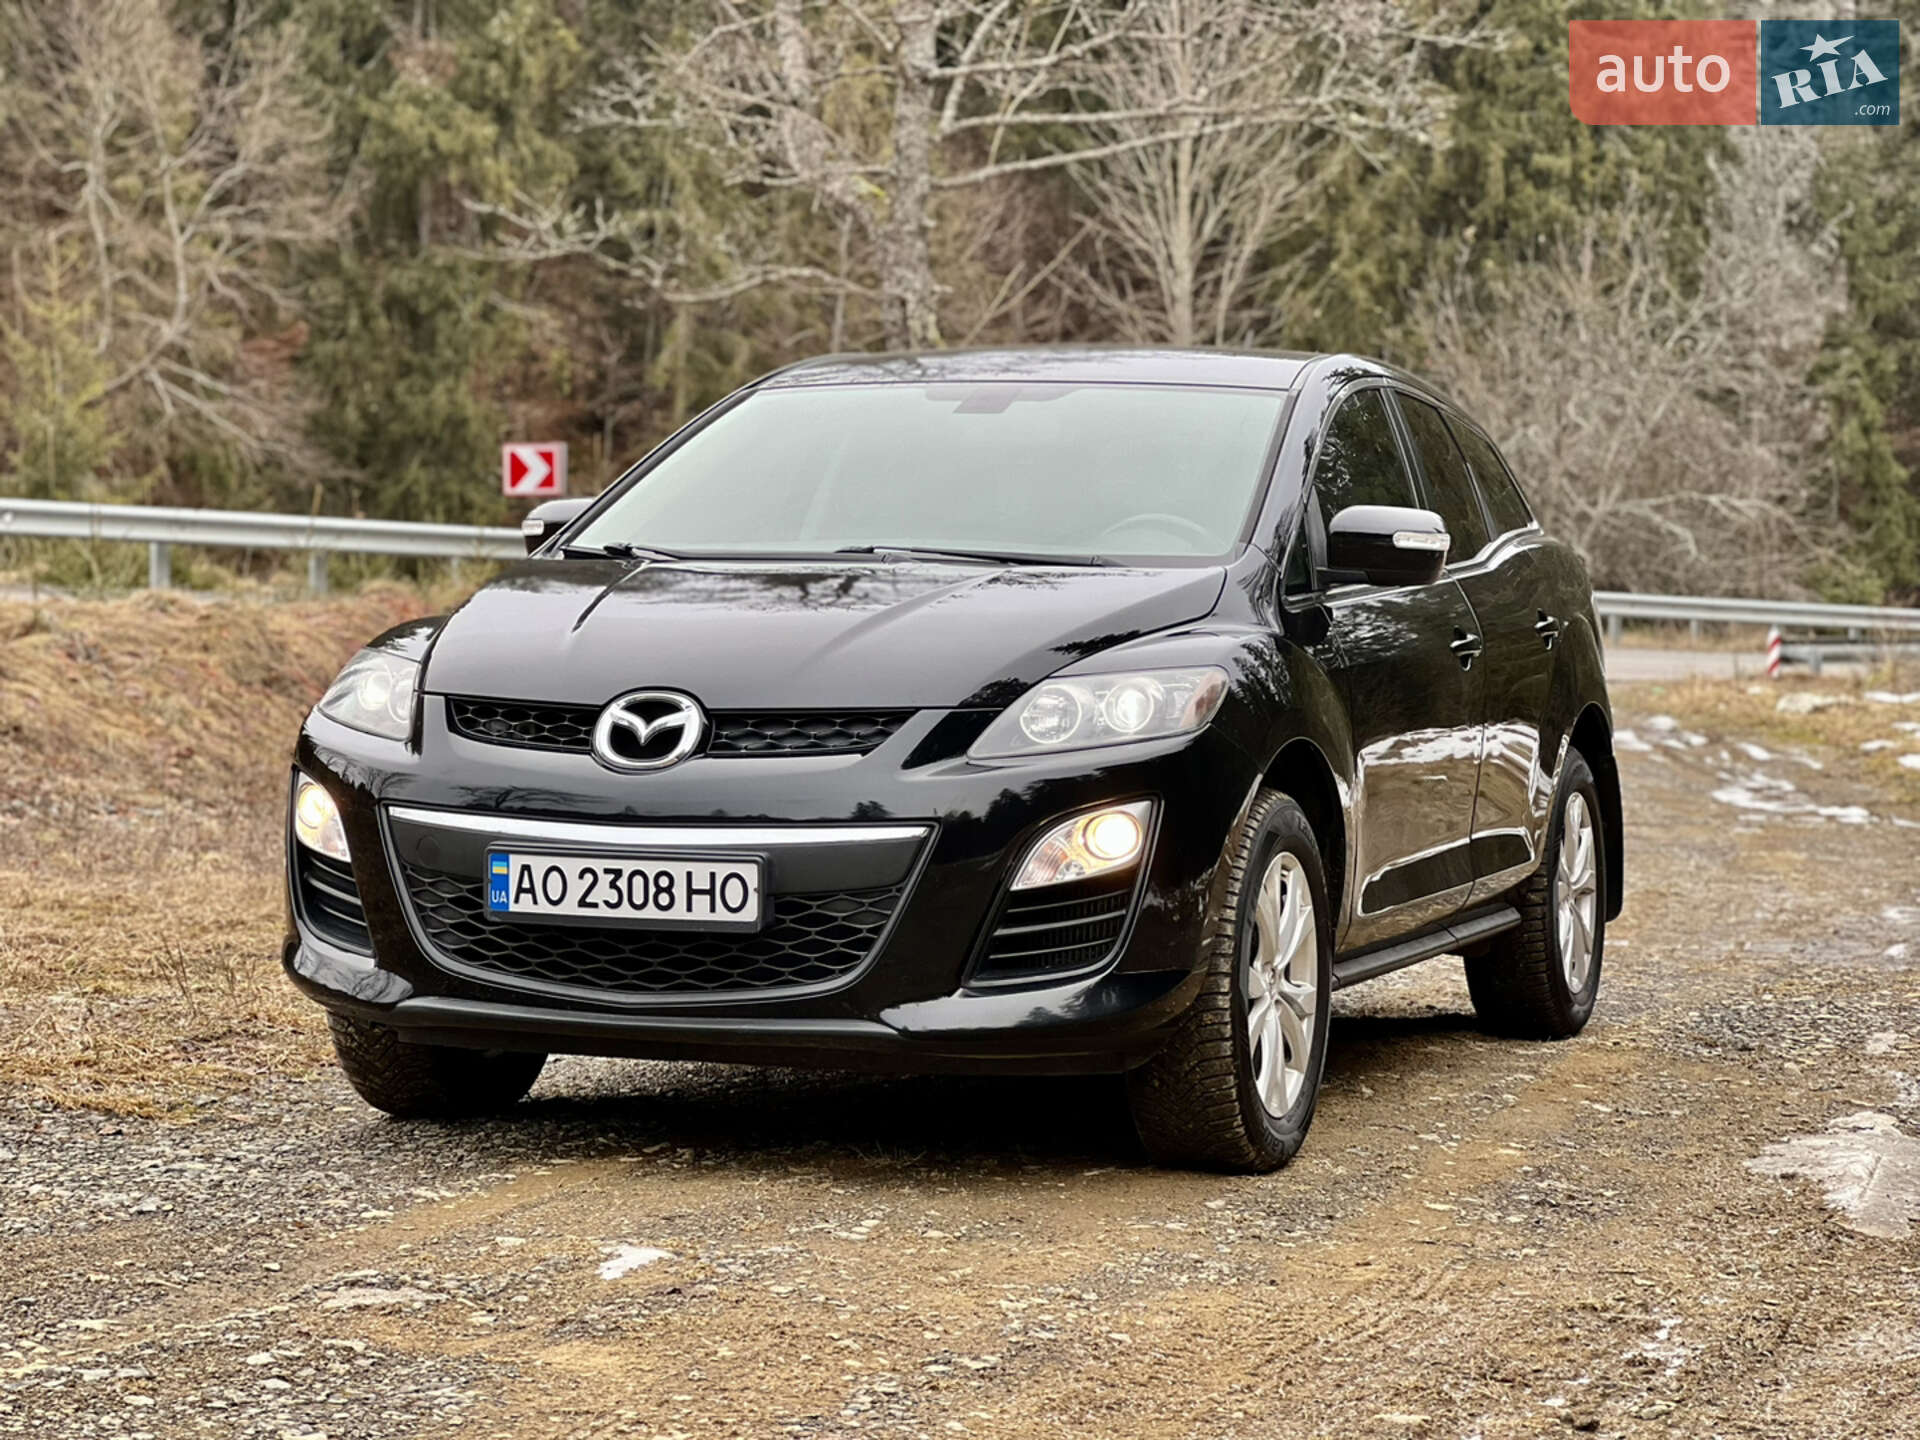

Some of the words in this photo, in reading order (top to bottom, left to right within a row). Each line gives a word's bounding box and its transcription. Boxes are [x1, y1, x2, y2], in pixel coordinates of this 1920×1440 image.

[491, 890, 508, 904] UA
[513, 864, 568, 906] AO
[577, 867, 676, 911] 2308
[686, 870, 749, 914] HO
